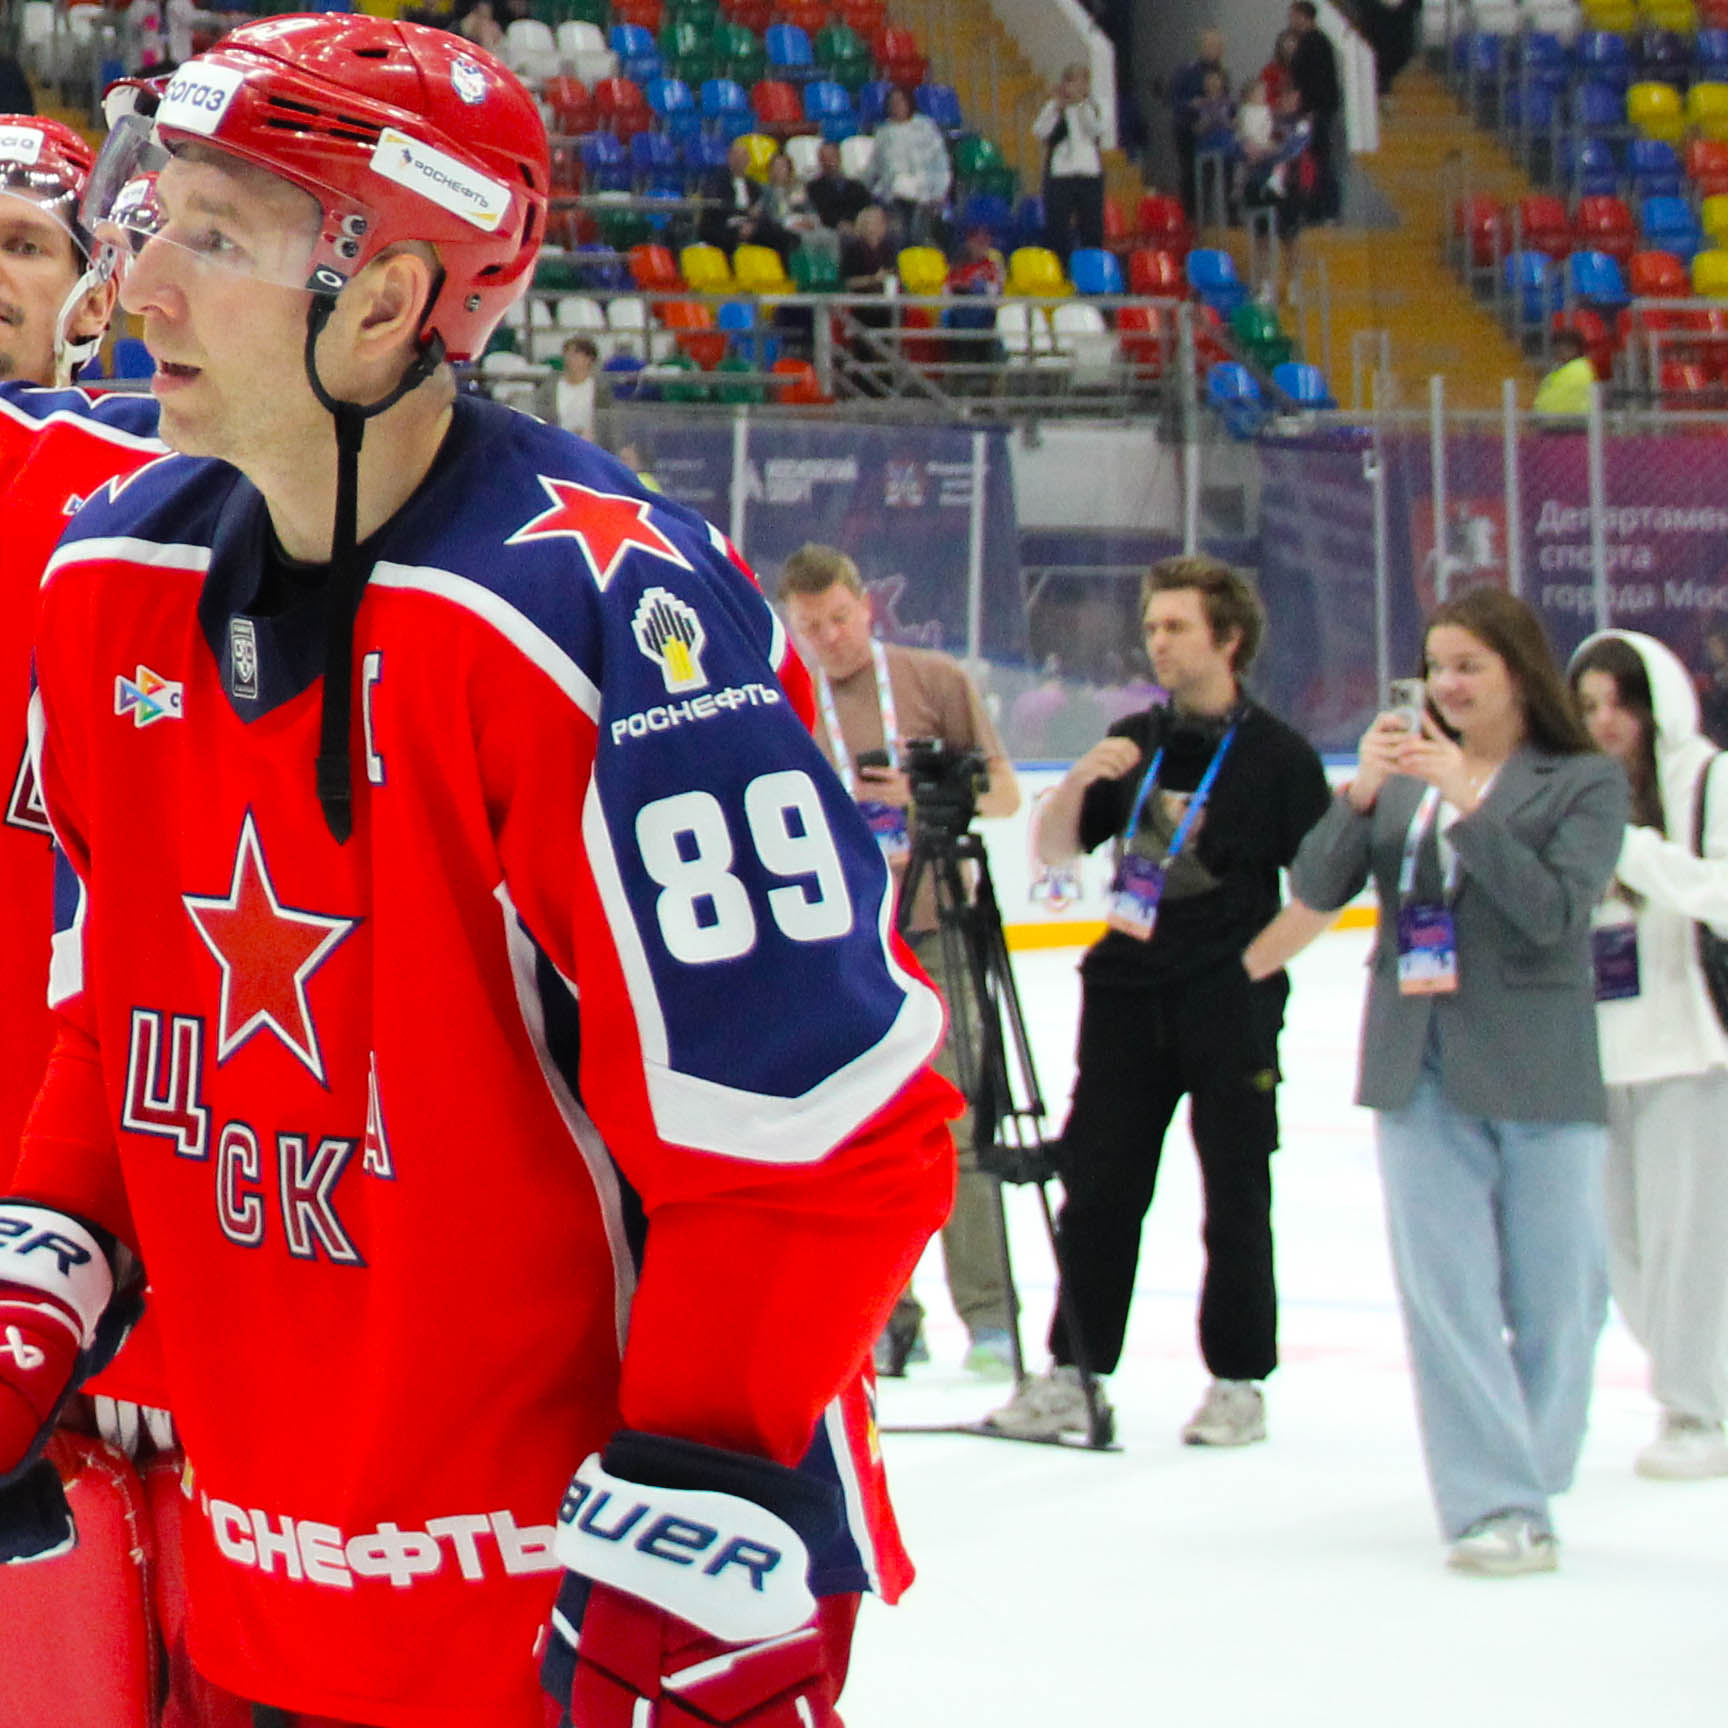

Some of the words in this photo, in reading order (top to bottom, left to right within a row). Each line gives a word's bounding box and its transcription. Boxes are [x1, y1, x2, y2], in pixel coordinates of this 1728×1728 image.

[413, 159, 490, 209] РОСНЕФТЬ
[610, 682, 781, 746] РОСНЕФТЬ
[633, 769, 854, 966] 89
[201, 1489, 561, 1589] СНЕФТЬ
